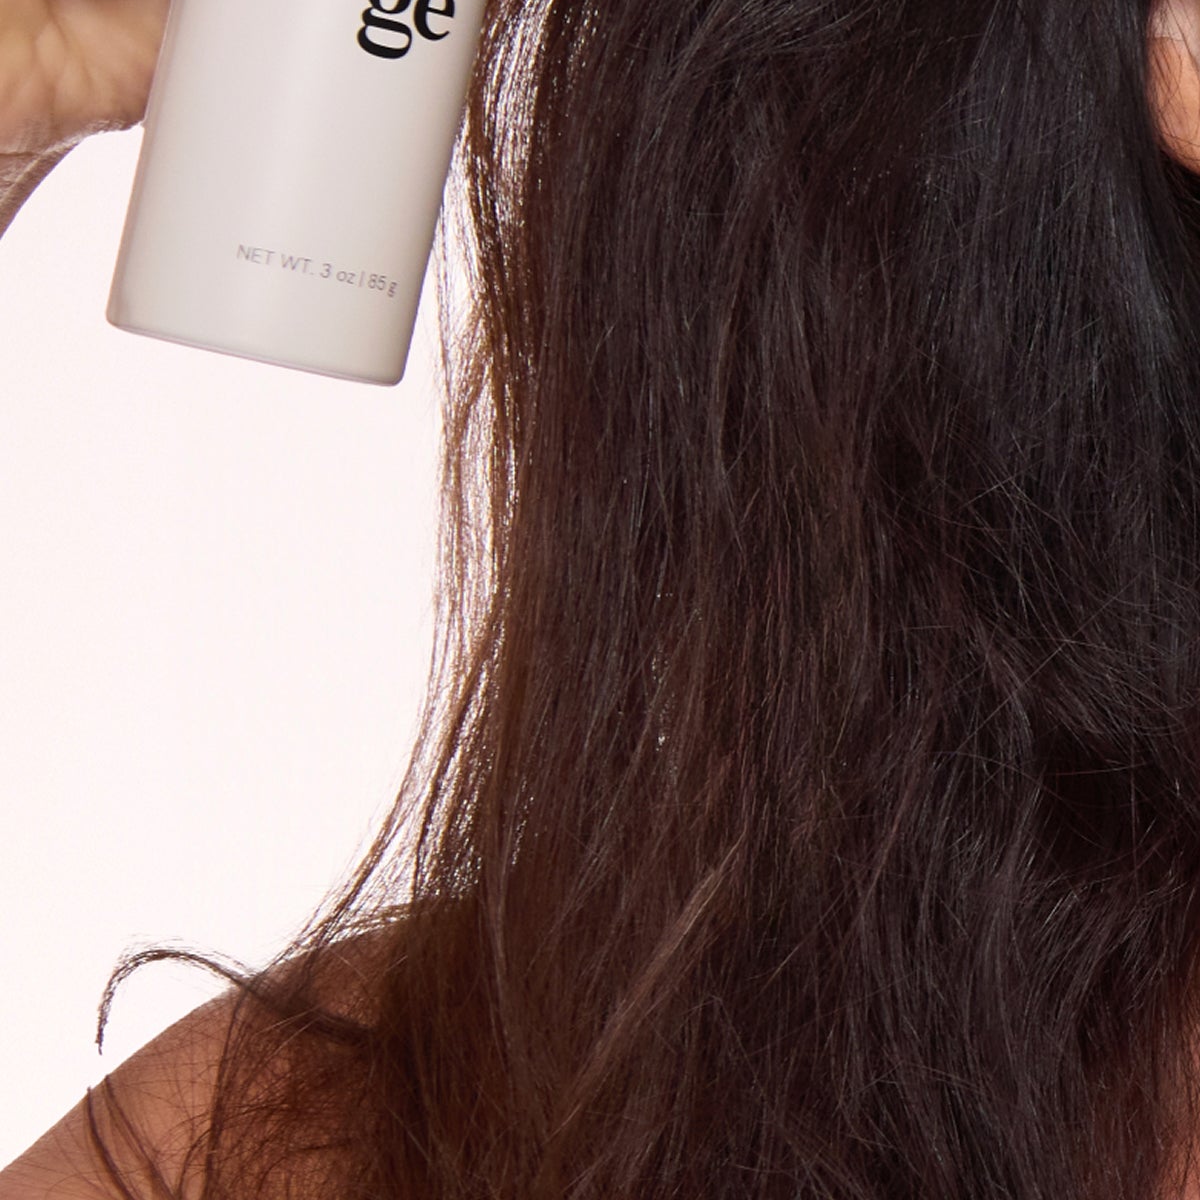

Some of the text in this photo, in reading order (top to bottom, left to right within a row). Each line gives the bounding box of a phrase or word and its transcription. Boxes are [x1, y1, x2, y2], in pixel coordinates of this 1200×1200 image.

[236, 244, 275, 265] NET
[281, 254, 314, 275] WT.
[319, 263, 332, 279] 3
[336, 270, 356, 285] oz
